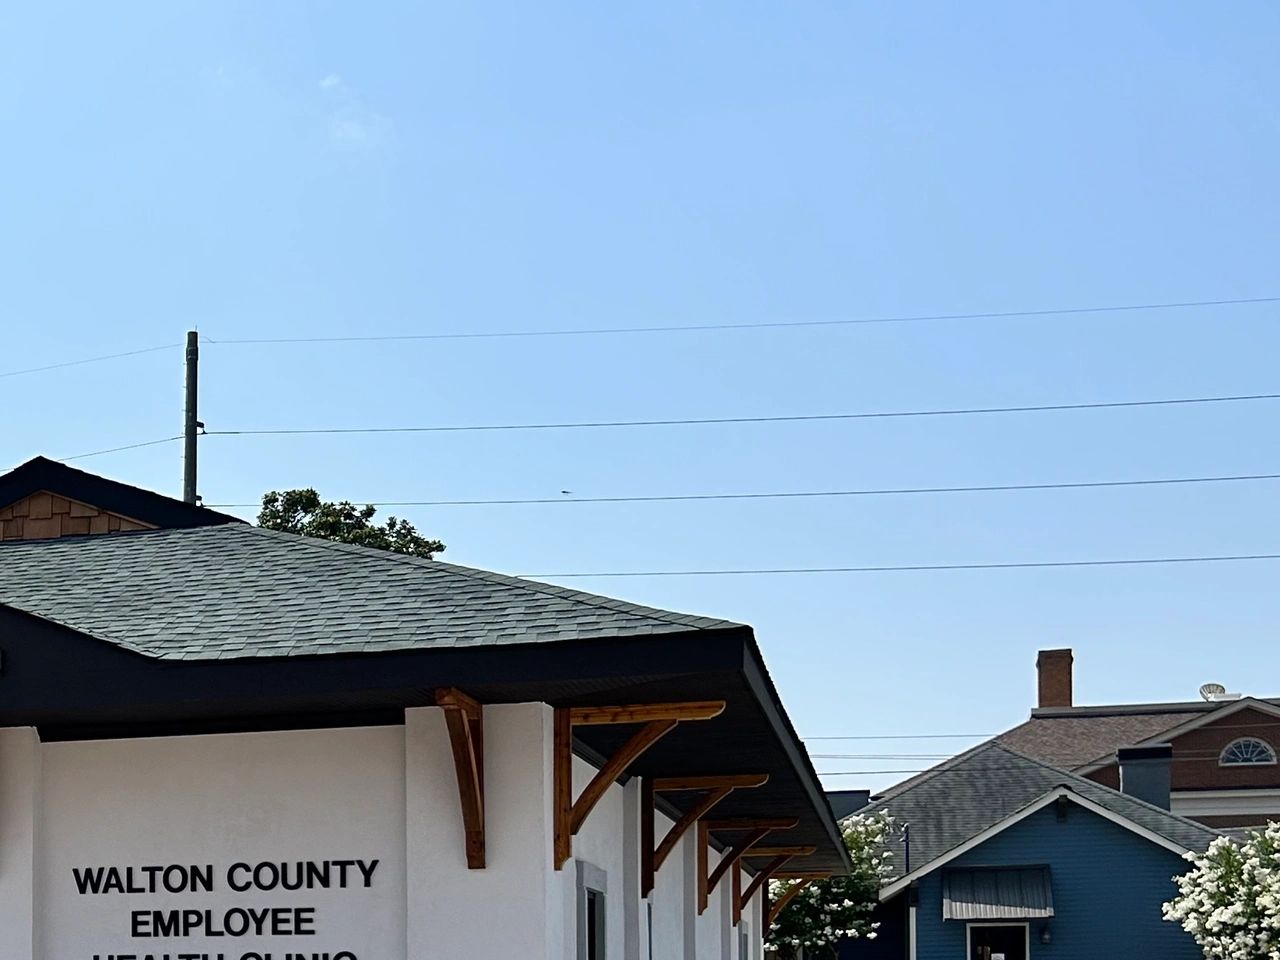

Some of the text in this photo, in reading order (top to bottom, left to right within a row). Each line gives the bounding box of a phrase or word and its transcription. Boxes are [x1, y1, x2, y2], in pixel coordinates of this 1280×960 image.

[72, 860, 379, 894] WALTON COUNTY
[132, 908, 315, 937] EMPLOYEE
